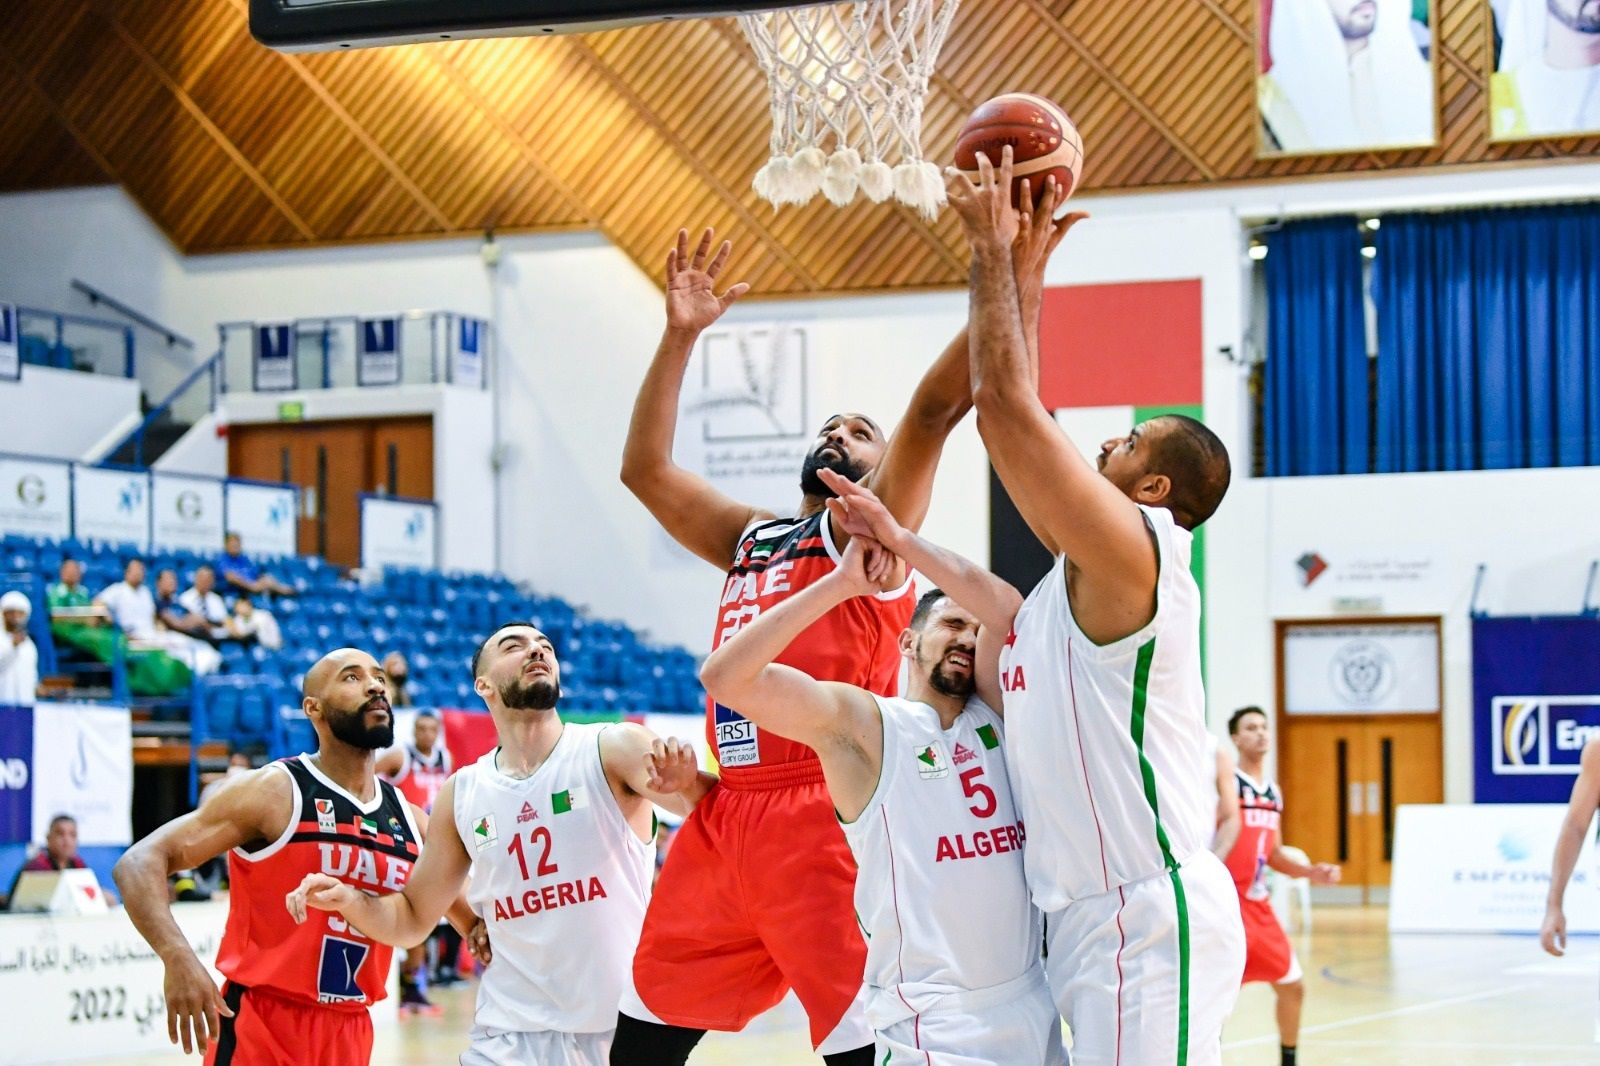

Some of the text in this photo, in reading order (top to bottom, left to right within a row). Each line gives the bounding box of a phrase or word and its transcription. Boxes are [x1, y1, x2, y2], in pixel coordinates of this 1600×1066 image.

[721, 561, 794, 607] UAE
[959, 766, 997, 818] 5
[516, 810, 539, 824] PEAK
[319, 843, 410, 893] UAE
[507, 826, 558, 880] 12
[494, 876, 607, 922] ALGERIA
[1452, 870, 1589, 884] EMPOWR
[68, 986, 127, 1024] 2022
